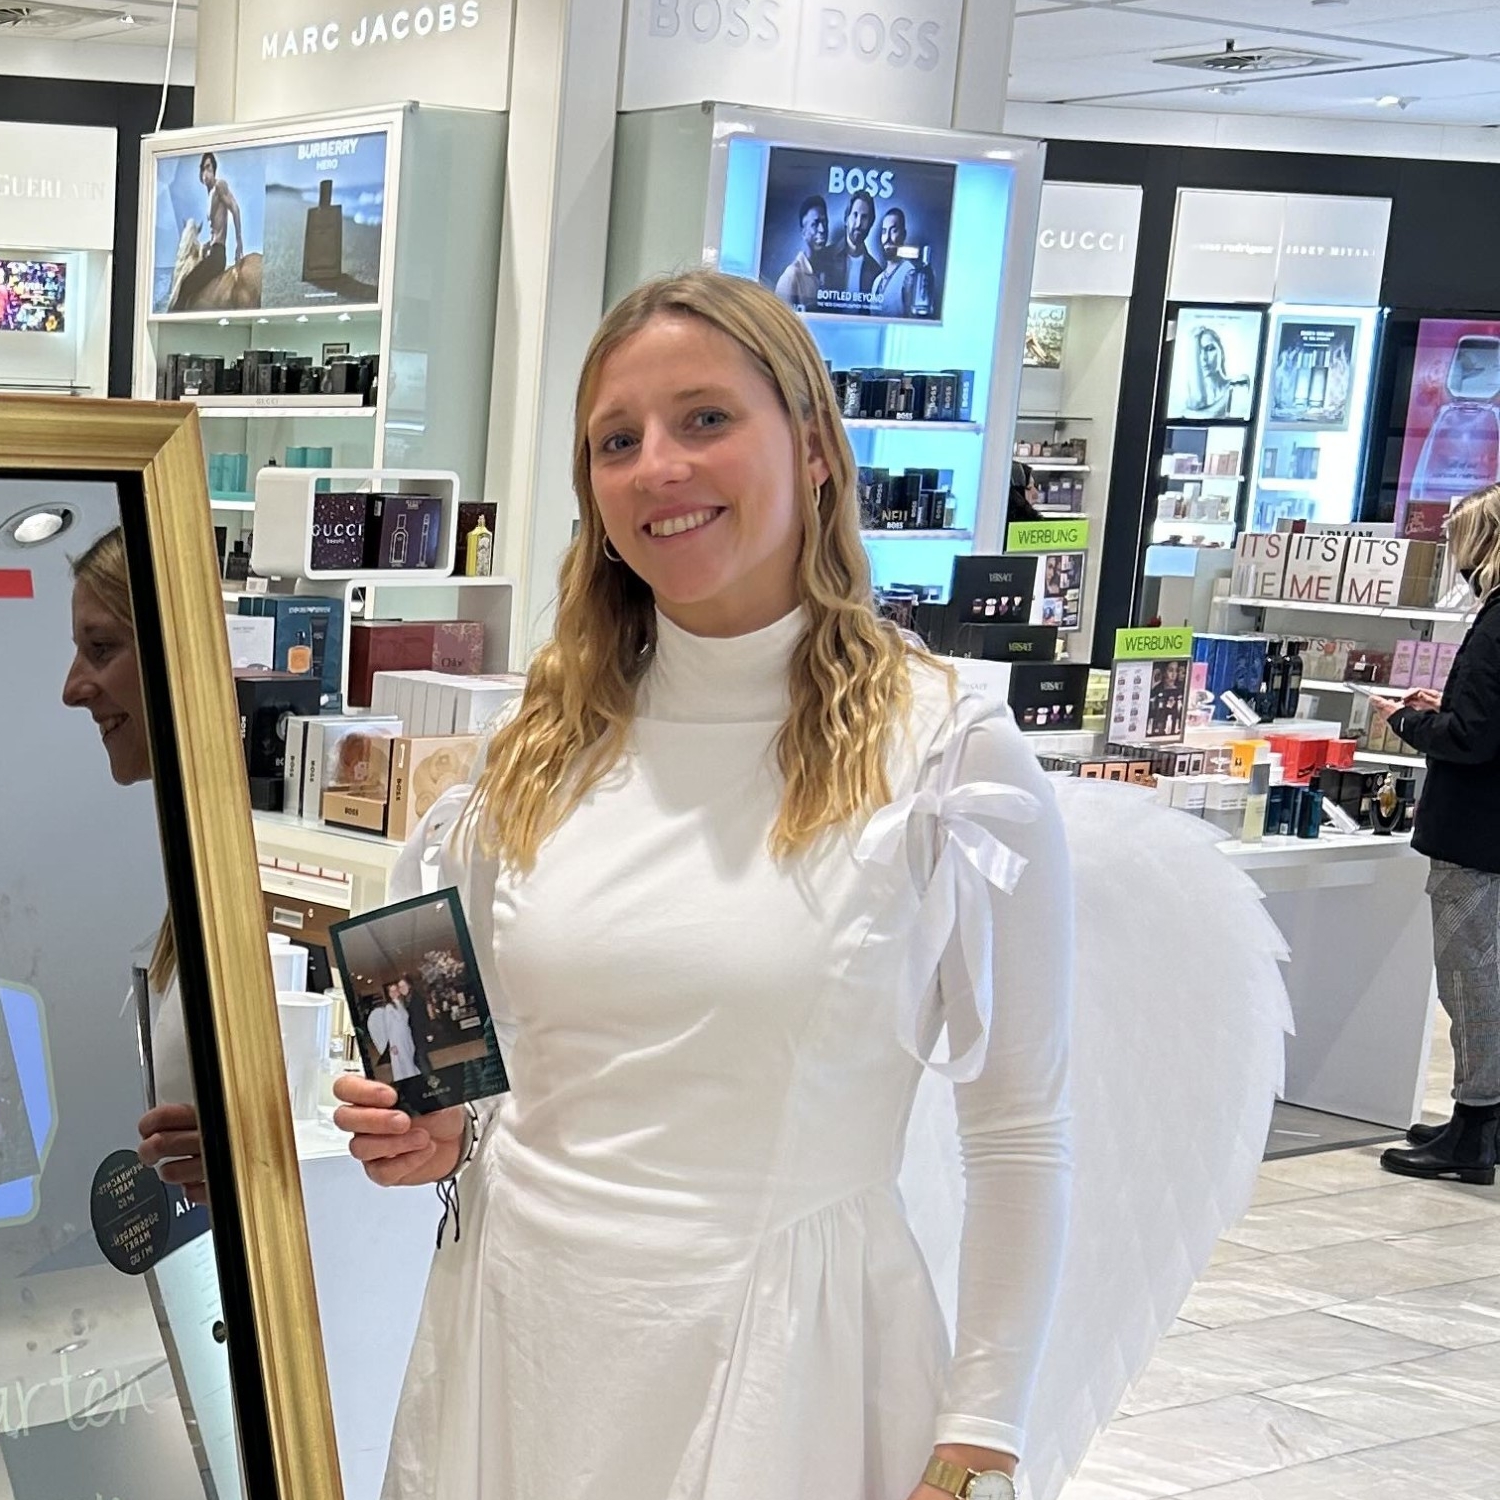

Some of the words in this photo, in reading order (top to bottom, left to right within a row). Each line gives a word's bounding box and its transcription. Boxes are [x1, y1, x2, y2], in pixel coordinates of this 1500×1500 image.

[261, 22, 340, 60] MARC
[351, 0, 479, 46] JACOBS
[818, 8, 941, 72] BOSS
[297, 138, 359, 161] BURBERRY
[316, 158, 338, 171] HERO
[828, 166, 894, 199] BOSS
[1039, 228, 1125, 252] GUCCI
[817, 289, 851, 302] BOTTLED
[312, 523, 362, 537] GUCCI
[1018, 528, 1078, 545] WERBUNG
[1241, 533, 1282, 559] IT'S
[1295, 536, 1339, 562] IT'S
[1354, 539, 1401, 566] IT'S
[1289, 574, 1332, 601] ME
[1347, 578, 1394, 606] ME
[1125, 635, 1184, 651] WERBUNG
